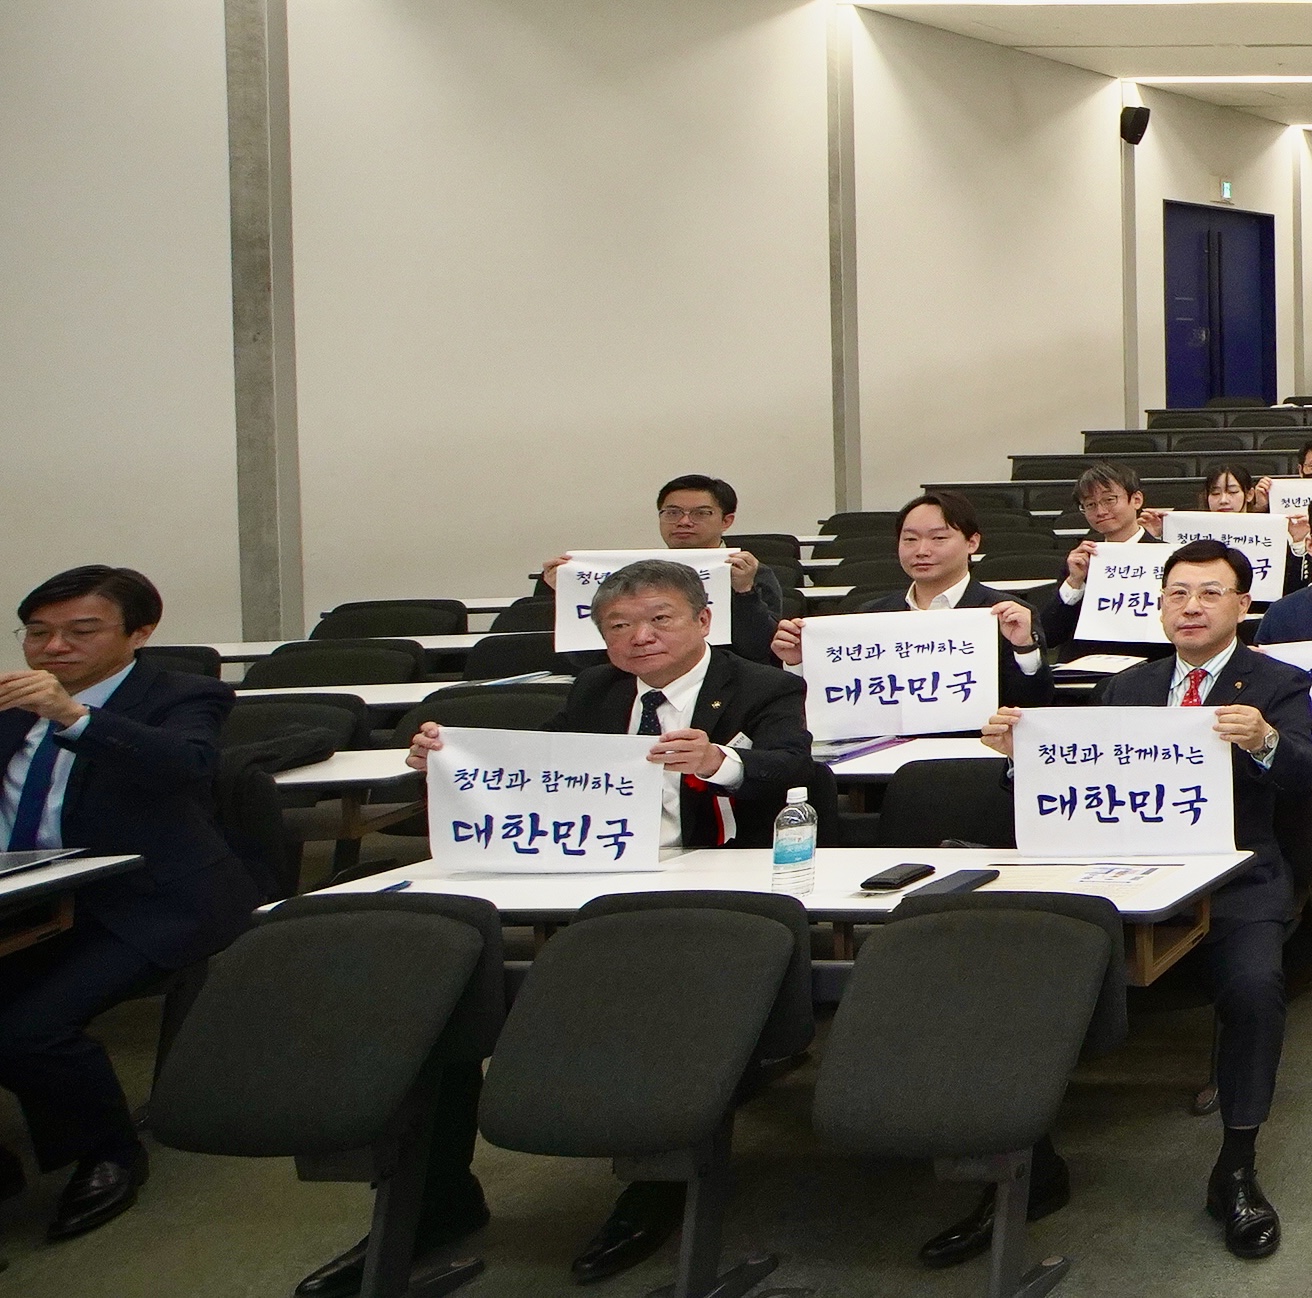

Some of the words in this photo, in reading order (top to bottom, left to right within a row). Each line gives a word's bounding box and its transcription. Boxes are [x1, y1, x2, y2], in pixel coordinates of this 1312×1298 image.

[576, 570, 609, 586] 청년
[1105, 565, 1146, 579] 청년과
[1098, 592, 1161, 618] 대한
[826, 644, 885, 663] 청년과
[895, 639, 974, 658] 함께하는
[825, 671, 977, 705] 대한민국
[1039, 743, 1103, 764] 청년과
[1114, 744, 1203, 765] 함께하는
[454, 768, 531, 791] 청년과
[542, 771, 634, 796] 함께하는
[1037, 784, 1208, 825] 대한민국
[452, 812, 634, 860] 대한민국
